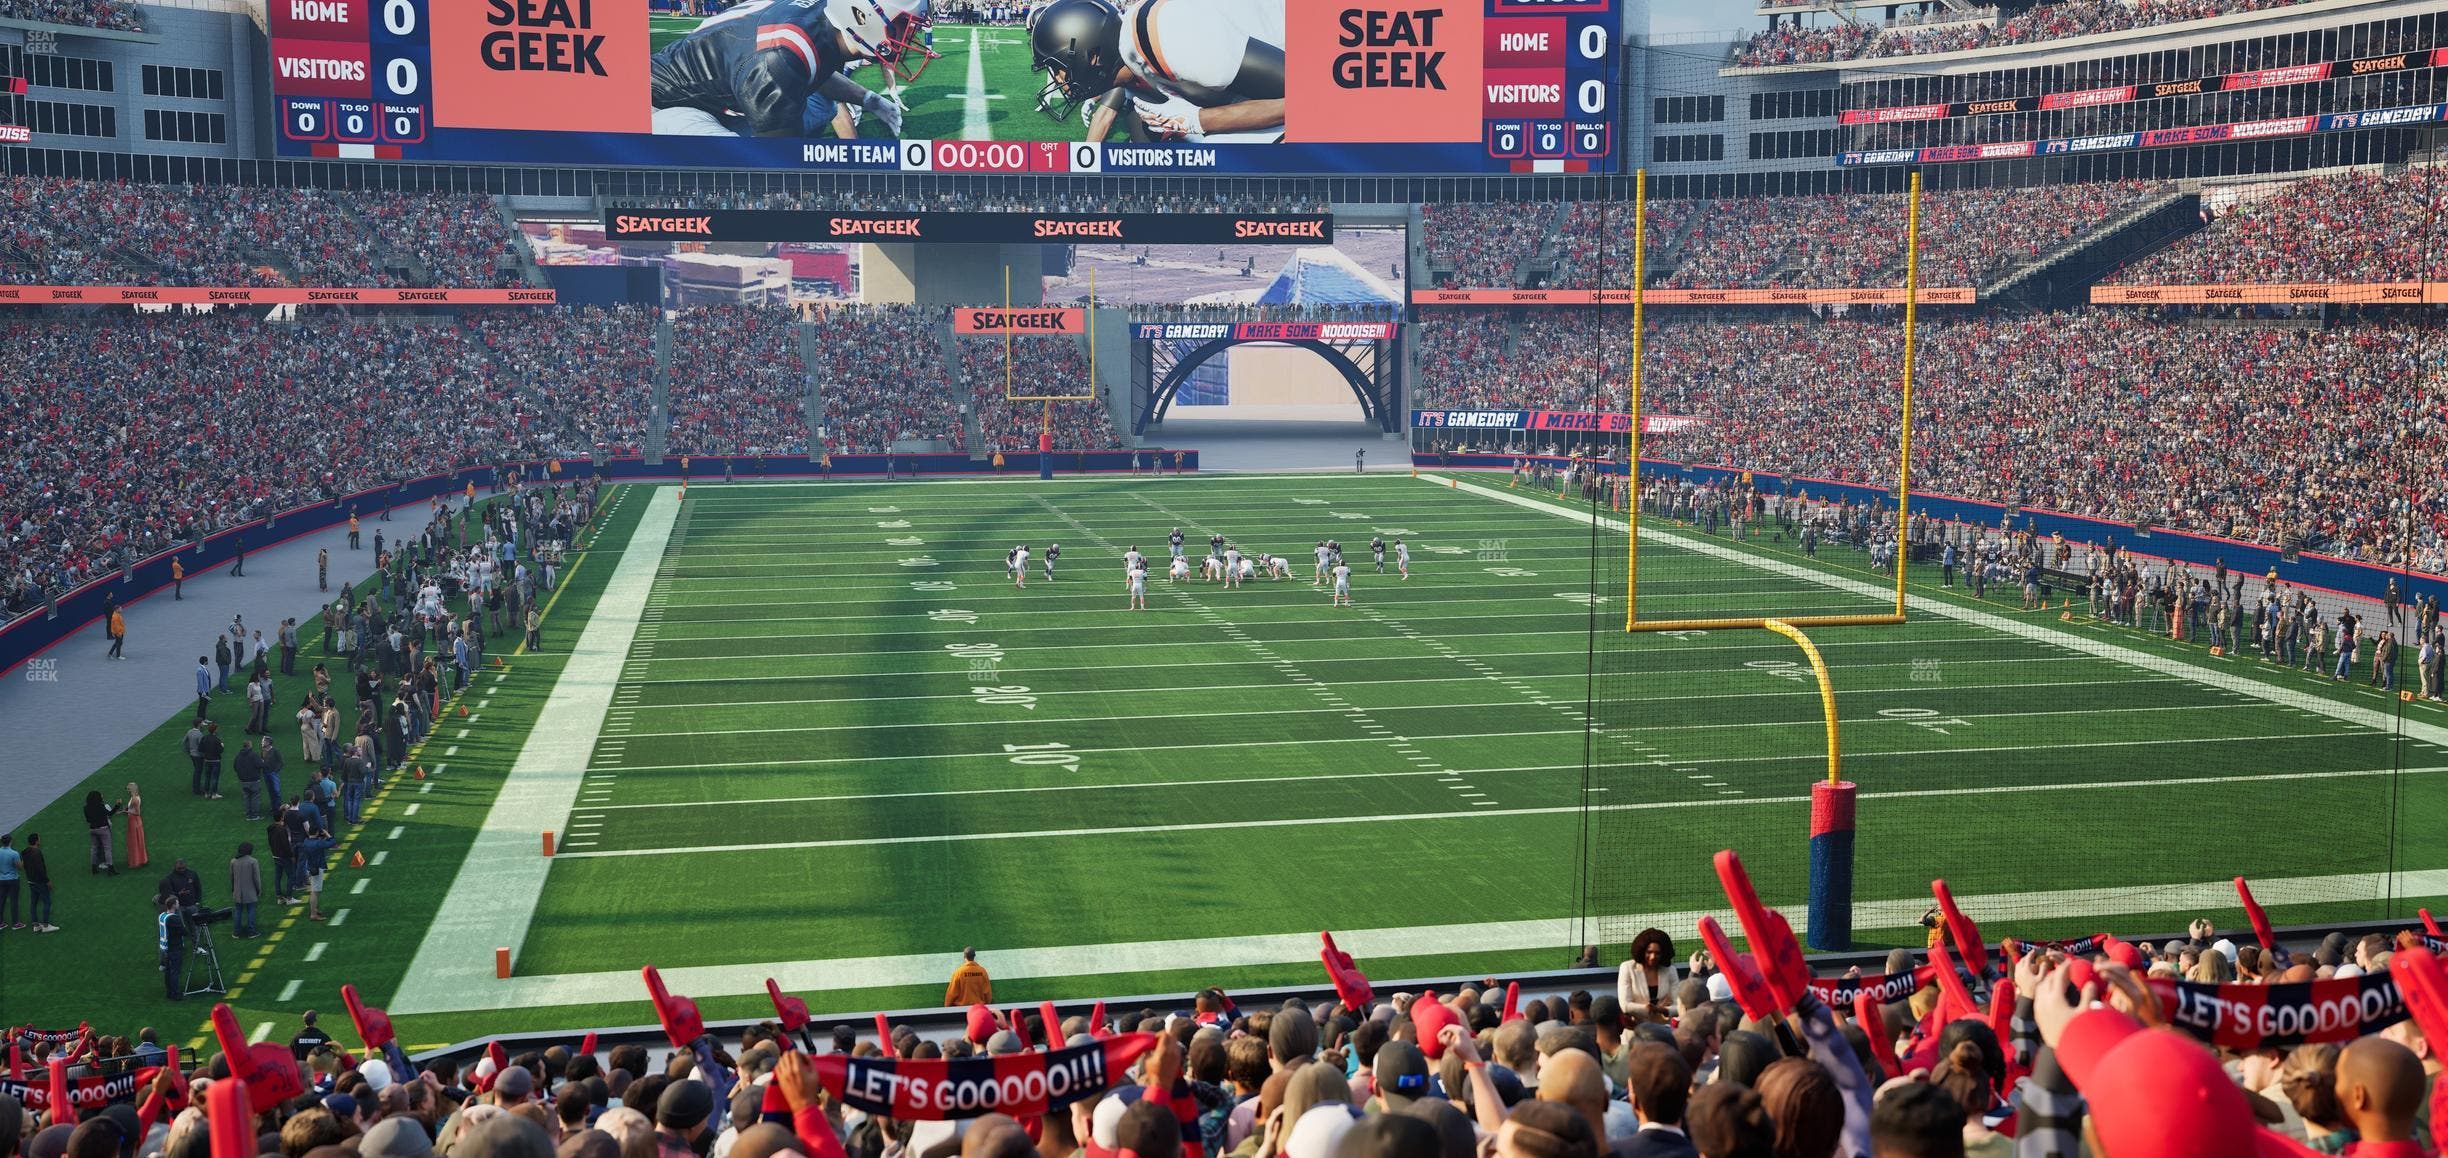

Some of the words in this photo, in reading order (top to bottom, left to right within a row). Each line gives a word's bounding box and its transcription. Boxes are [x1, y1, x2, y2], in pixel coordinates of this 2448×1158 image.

[290, 0, 348, 23] HOME
[383, 0, 416, 36] 0
[1338, 8, 1444, 48] SEAT
[1500, 32, 1549, 52] HOME
[1578, 24, 1608, 60] 0
[480, 30, 609, 77] GEEK
[1331, 51, 1448, 91] GEEK
[2351, 54, 2407, 74] SEATGEEK
[277, 56, 366, 82] VISITORS
[385, 57, 418, 96] 0
[2260, 65, 2320, 84] GAMEDAY!
[1486, 84, 1561, 104] VISITORS
[1577, 79, 1606, 114] 0
[2073, 88, 2126, 105] GAMEDAY!
[2154, 79, 2202, 97] SEATGEEK
[291, 102, 321, 111] DOWN
[339, 104, 352, 112] TO
[354, 105, 370, 113] GO
[385, 106, 406, 114] BALL
[407, 106, 420, 114] ON
[1878, 106, 1939, 121] GAMEDAY!
[1967, 99, 2018, 115] SEATGEEK
[298, 113, 316, 132] 0
[347, 115, 364, 134] 0
[2360, 105, 2437, 127] GAMEDAY!
[394, 117, 412, 135] 0
[1500, 133, 1515, 151] 0
[1541, 133, 1556, 151] 0
[1583, 133, 1598, 150] 0
[2070, 134, 2135, 151] GAMEDAY!
[2152, 130, 2190, 144] MAKE
[2193, 126, 2229, 141] SOME
[803, 144, 848, 164] HOME
[853, 145, 896, 165] TEAM
[1040, 141, 1059, 151] QRT
[1927, 147, 1954, 161] MAKE
[1957, 146, 1980, 159] SOME
[906, 143, 927, 168] 0
[937, 142, 1025, 169] 00:00
[1045, 151, 1054, 169] 1
[1075, 144, 1097, 169] 0
[1107, 148, 1173, 168] VISITORS
[1175, 149, 1216, 167] TEAM
[1863, 150, 1914, 164] GAMEDAY!
[616, 215, 713, 235] SEATGEEK
[829, 217, 922, 237] SEATGEEK
[1033, 219, 1123, 238] SEATGEEK
[1234, 220, 1325, 238] SEATGEEK
[52, 290, 83, 300] SEATGEEK
[121, 291, 159, 300] SEATGEEK
[208, 291, 251, 300] SEATGEEK
[308, 291, 359, 301] SEATGEEK
[398, 291, 448, 301] SEATGEEK
[508, 291, 554, 301] SEATGEEK
[1438, 293, 1471, 301] SEATGEEK
[1512, 293, 1548, 301] SEATGEEK
[1689, 292, 1726, 301] SEATGEEK
[1771, 292, 1808, 300] SEATGEEK
[1851, 291, 1885, 300] SEATGEEK
[1927, 291, 1962, 300] SEATGEEK
[2126, 290, 2160, 300] SEATGEEK
[2205, 289, 2243, 299] SEATGEEK
[2290, 288, 2330, 299] SEATGEEK
[2382, 287, 2423, 299] SEATGEEK
[973, 311, 1066, 330] SEATGEEK
[1139, 324, 1163, 339] IT'S
[1165, 324, 1229, 339] GAMEDAY!
[1245, 325, 1280, 338] MAKE
[1285, 325, 1318, 338] SOME
[1320, 324, 1387, 338] NOOOOISE!!!
[1418, 411, 1446, 427] IT'S
[1447, 411, 1519, 428] GAMEDAY!
[1544, 413, 1603, 430] MAKE
[944, 642, 1005, 658] 30
[970, 685, 1038, 704] 20
[1002, 742, 1081, 765] 10
[2176, 986, 2252, 1035] LET'S
[24, 1029, 43, 1041] LET'S
[845, 1063, 928, 1109] LET'S
[933, 1049, 1105, 1111] GOOOOO!!!
